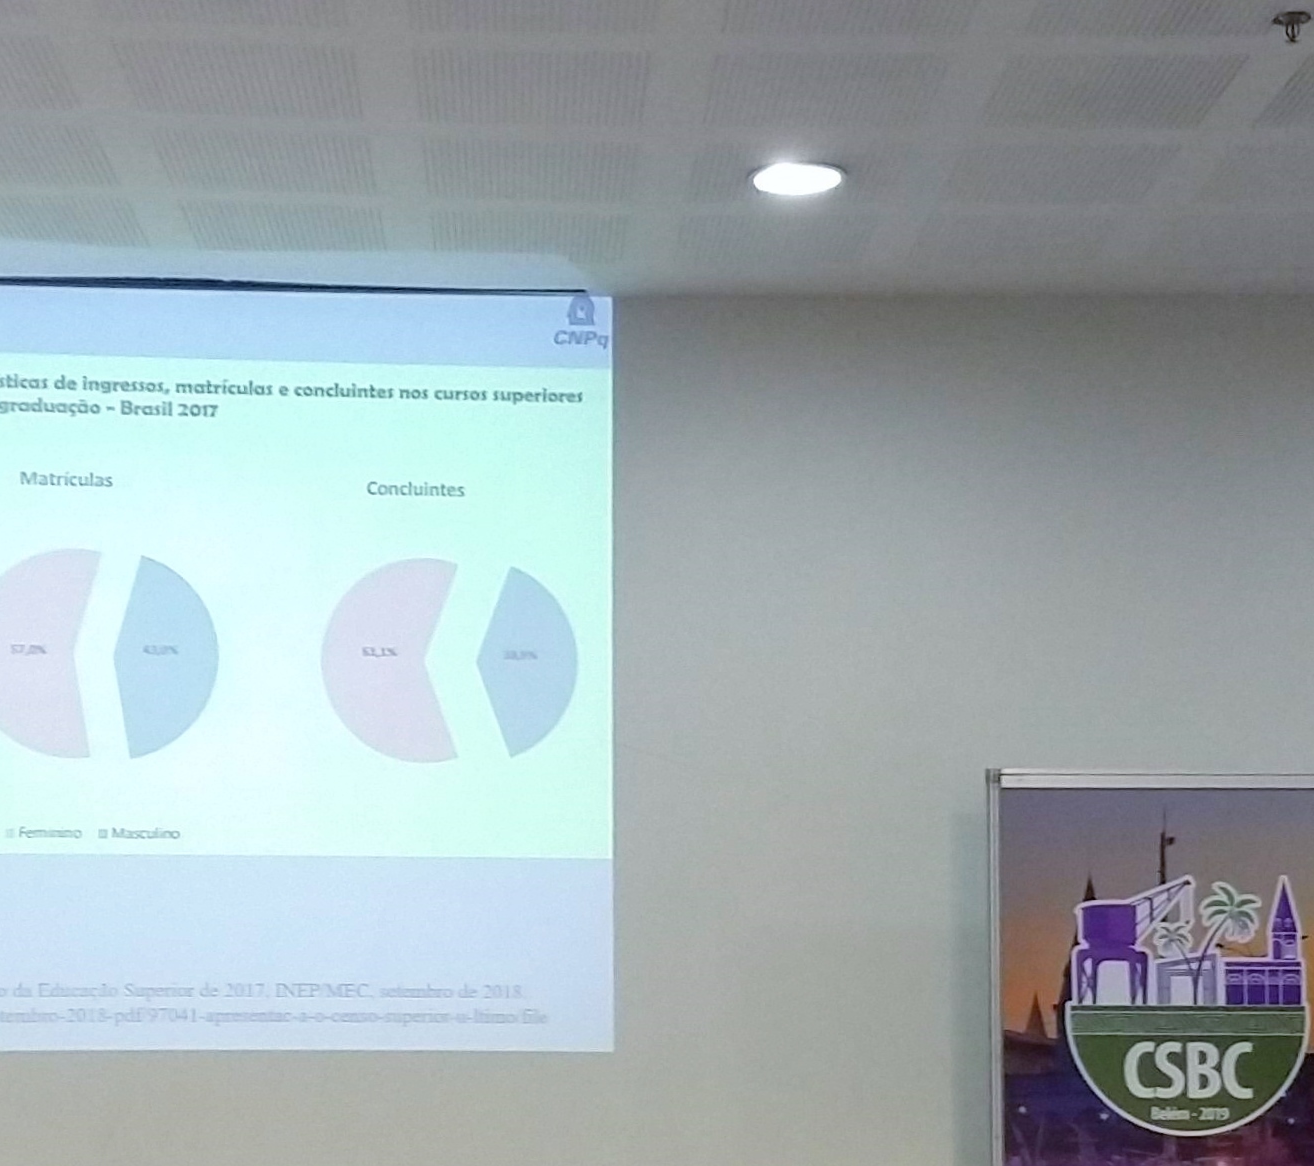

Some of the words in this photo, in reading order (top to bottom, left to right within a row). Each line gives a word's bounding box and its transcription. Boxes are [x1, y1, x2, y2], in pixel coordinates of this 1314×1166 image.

[553, 328, 609, 349] CNPq
[54, 374, 77, 391] de
[82, 376, 170, 396] ingressos,
[175, 379, 273, 396] matrículas
[278, 384, 289, 397] e
[293, 382, 394, 400] concluintes
[399, 387, 428, 400] nos
[433, 389, 487, 402] cursos
[492, 387, 584, 405] superiores
[120, 400, 173, 417] Brasil
[177, 403, 219, 418] 2017
[19, 469, 114, 487] Matrículas
[366, 480, 466, 498] Concluintes
[111, 827, 181, 840] Masculino
[124, 983, 194, 1001] Superior
[199, 983, 219, 998] de
[380, 983, 453, 999] setembro
[458, 983, 477, 998] de
[1124, 1041, 1254, 1099] CSBC
